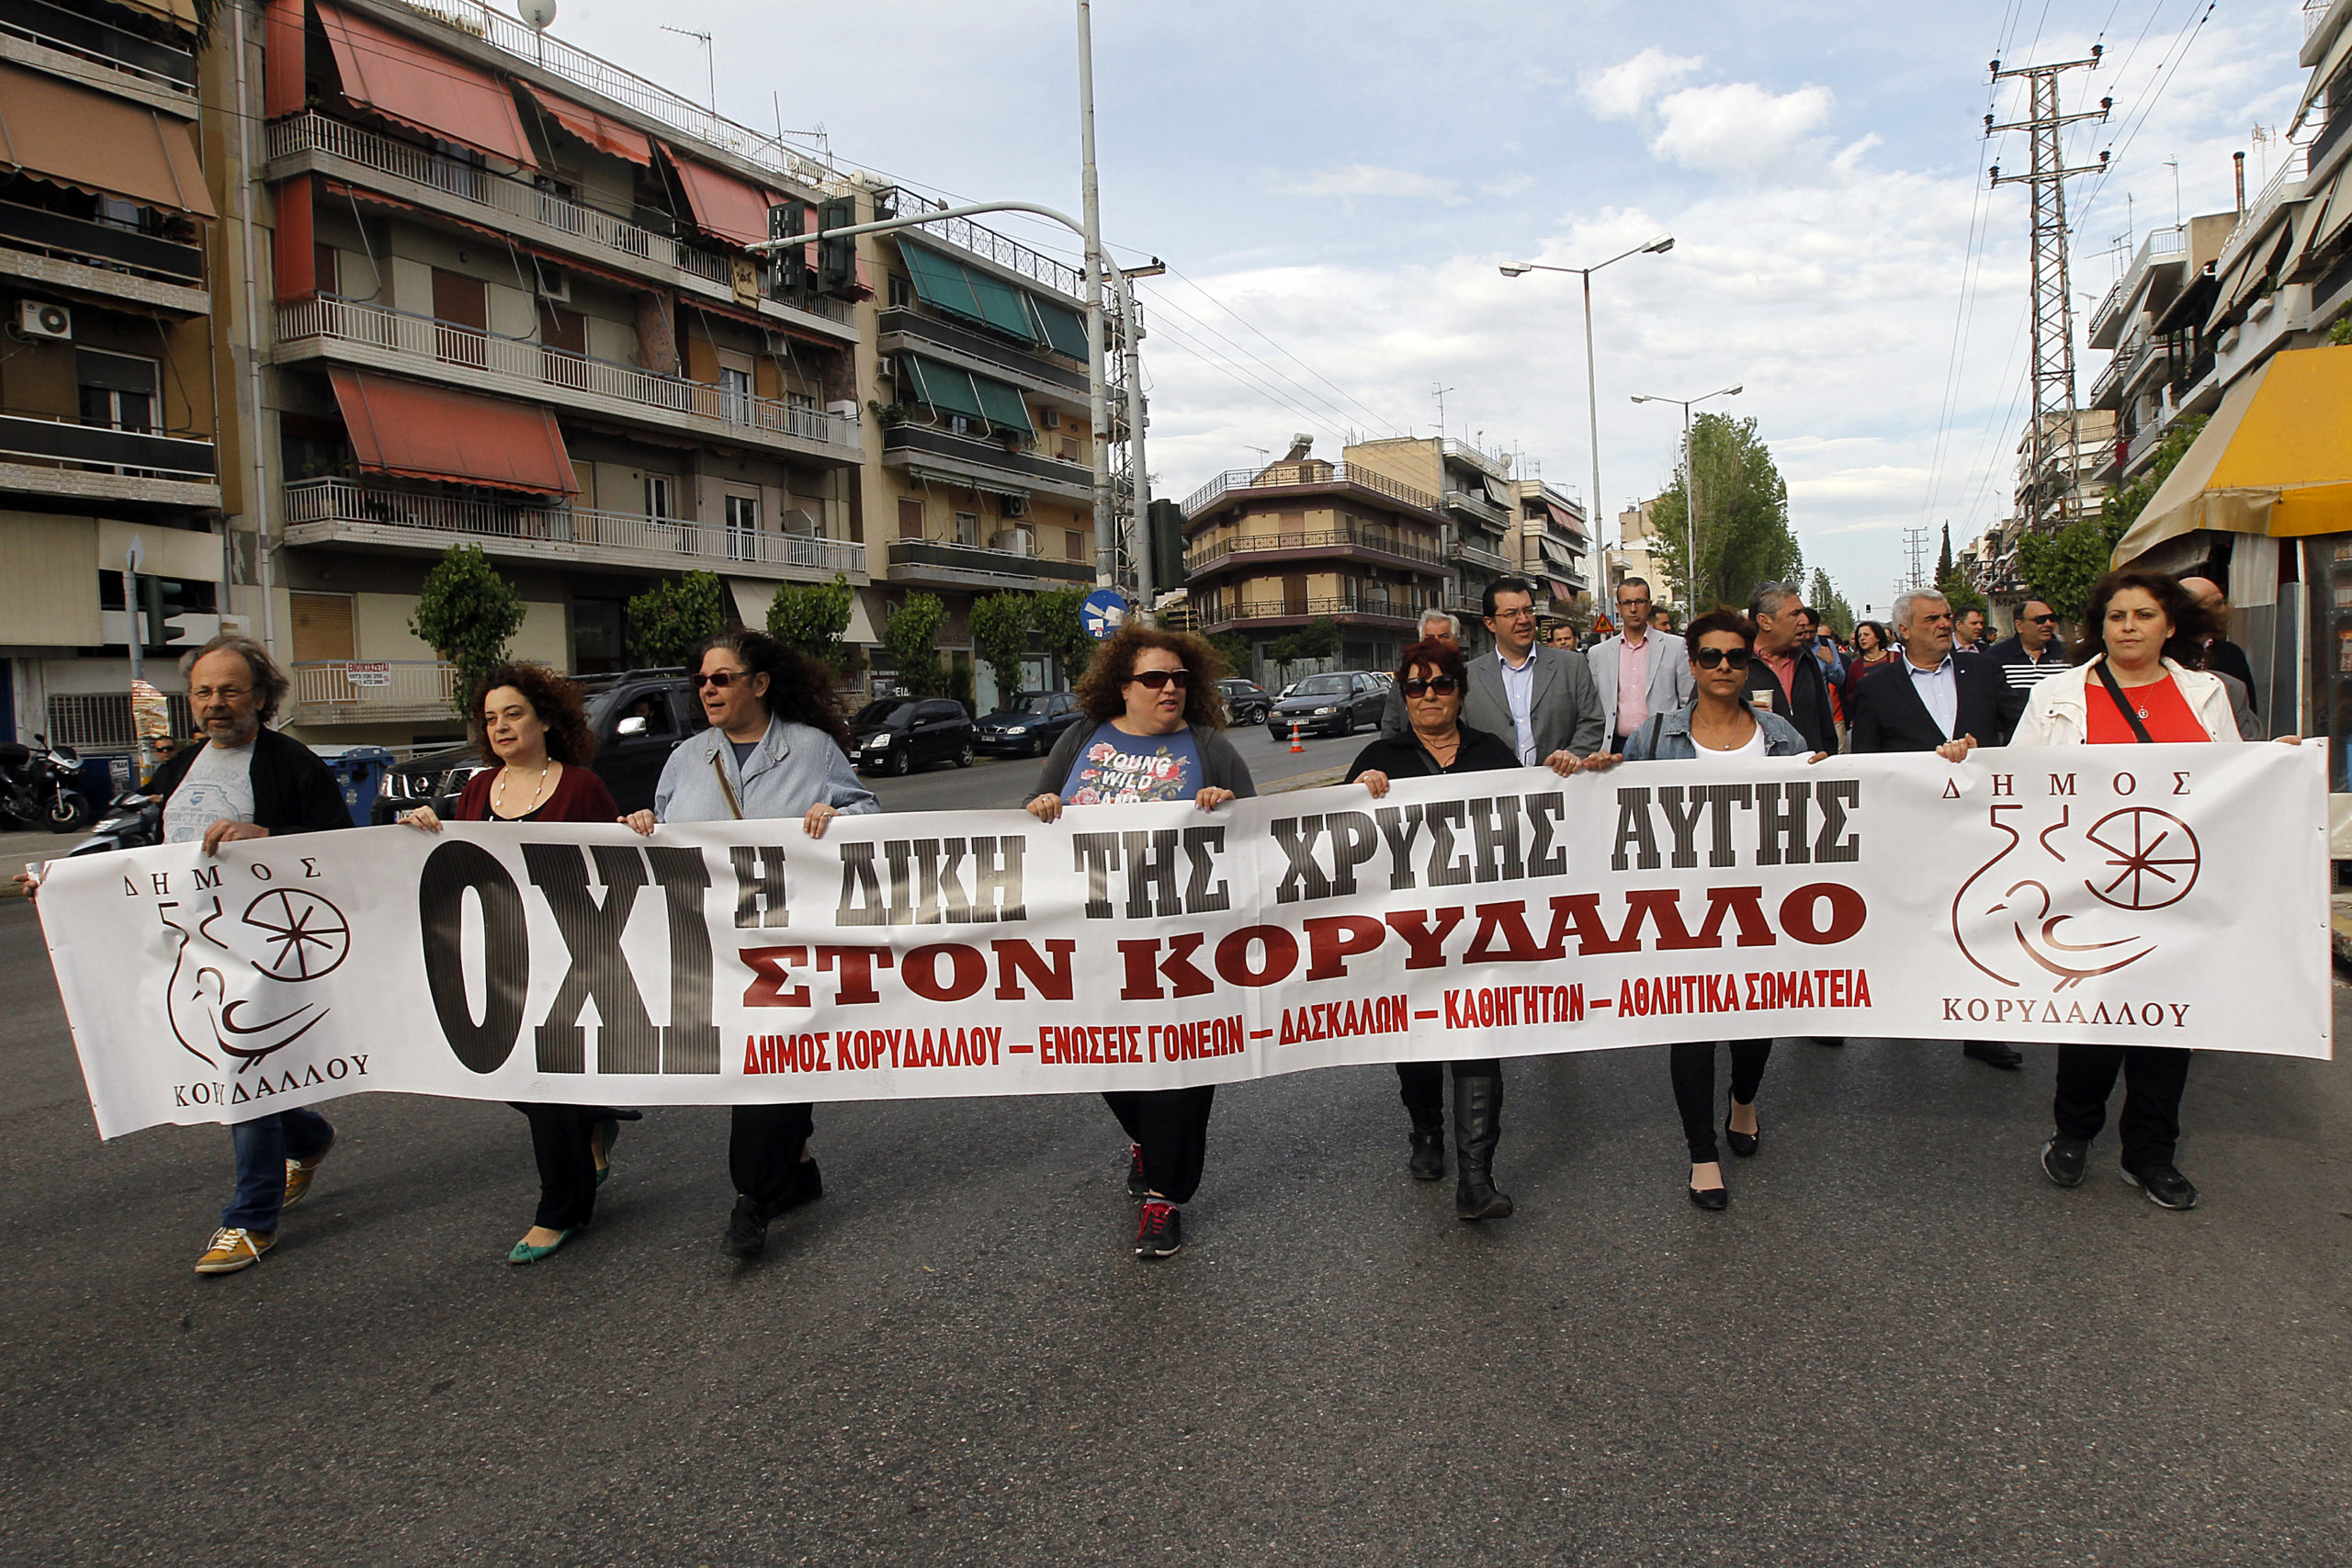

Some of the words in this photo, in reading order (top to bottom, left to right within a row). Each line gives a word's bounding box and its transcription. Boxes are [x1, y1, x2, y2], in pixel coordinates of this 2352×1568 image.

[1102, 751, 1171, 778] YOUNG
[1102, 771, 1153, 790] WILD
[1941, 771, 2191, 799] ΔΗΜΟΣ
[729, 845, 790, 929] Η
[835, 835, 1027, 927] ΔΙΚΗ
[1072, 826, 1231, 919] ΤΗΣ
[1270, 791, 1568, 905] ΧΡΥΣΗΣ
[1611, 779, 1860, 873] ΑΥΓΗΣ
[124, 856, 322, 897] ΔΗΜΟΣ
[418, 839, 722, 1076] ΟΧΙ
[738, 938, 1078, 1008] ΣΤΟΝ
[1116, 882, 1868, 1001] ΚΟΡΥΔΑΛΛΟ
[742, 1031, 831, 1076] ΔΗΜΟΣ
[836, 1026, 1002, 1071] ΚΟΡΥΔΑΛΛΟΥ
[1038, 1025, 1144, 1065] ΕΝΩΣΕΙΣ
[1148, 1014, 1245, 1064] ΓΟΝΕΩΝ
[1278, 994, 1408, 1045] ΔΑΣΚΑΛΩΝ
[1443, 982, 1585, 1030] ΚΑΘΗΓΗΤΩΝ
[1617, 973, 1741, 1019] ΑΘΛΗΤΙΚΑ
[1745, 968, 1872, 1011] ΣΩΜΑΤΕΙΑ
[1941, 997, 2191, 1028] ΚΟΡΥΔΑΛΛΟΥ
